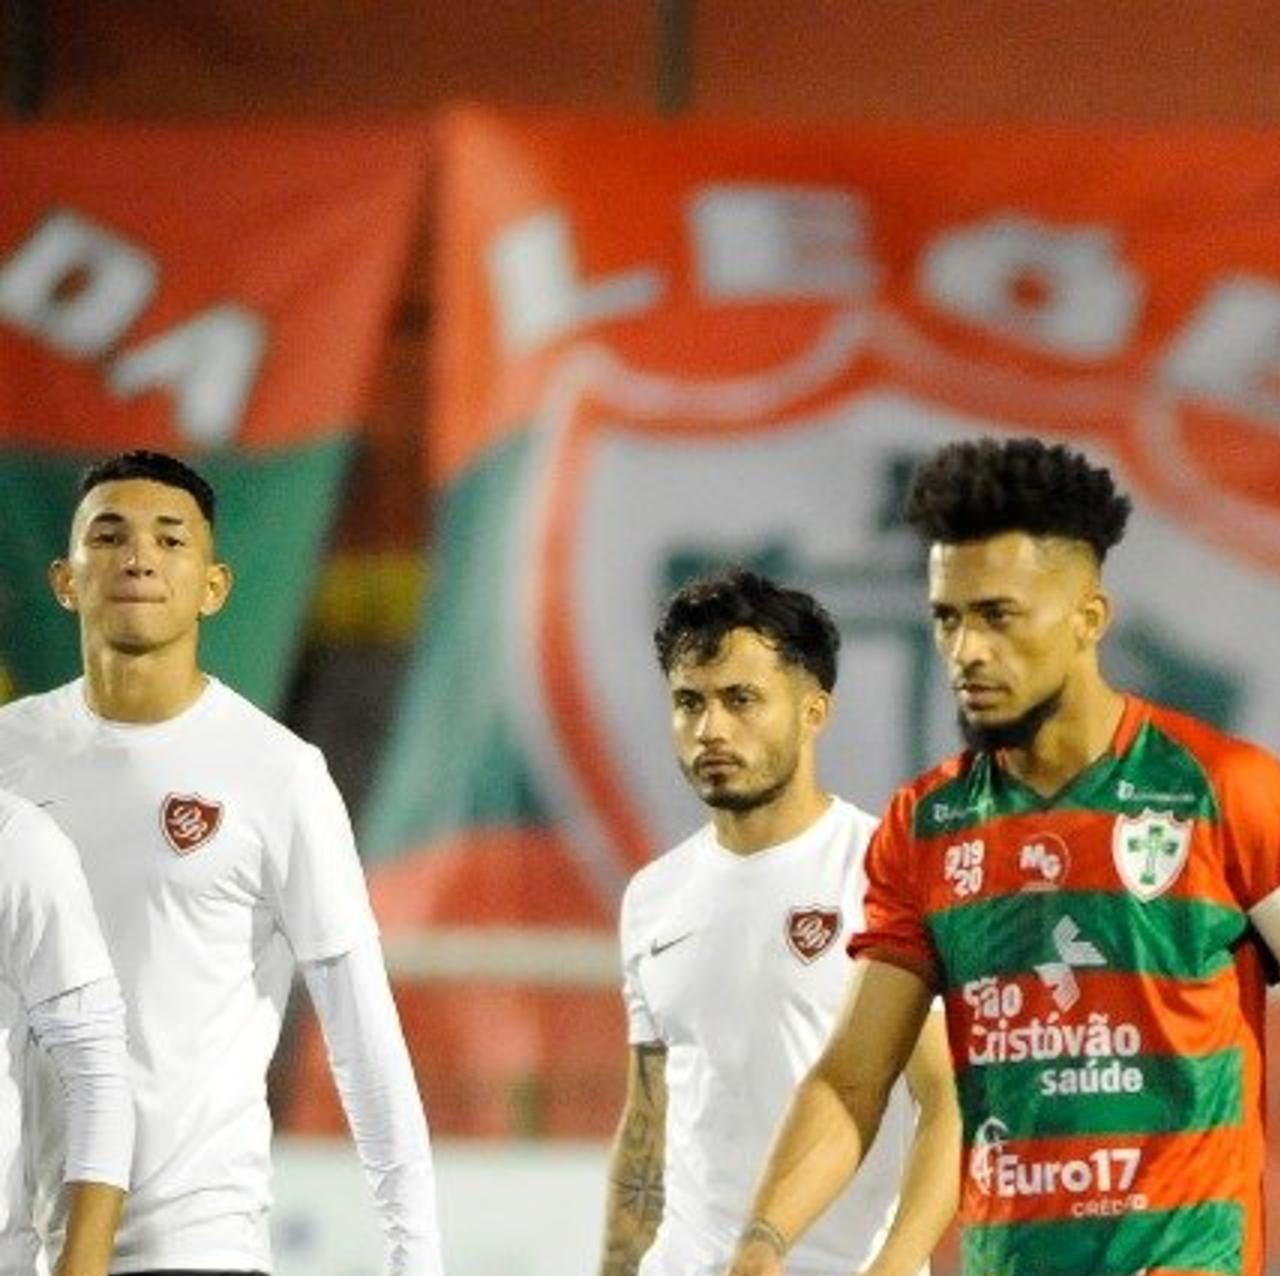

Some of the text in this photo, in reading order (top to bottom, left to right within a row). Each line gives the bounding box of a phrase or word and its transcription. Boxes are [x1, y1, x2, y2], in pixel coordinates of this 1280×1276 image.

[953, 867, 984, 896] 20
[1040, 1059, 1145, 1095] saúde
[998, 1148, 1142, 1197] Euro17
